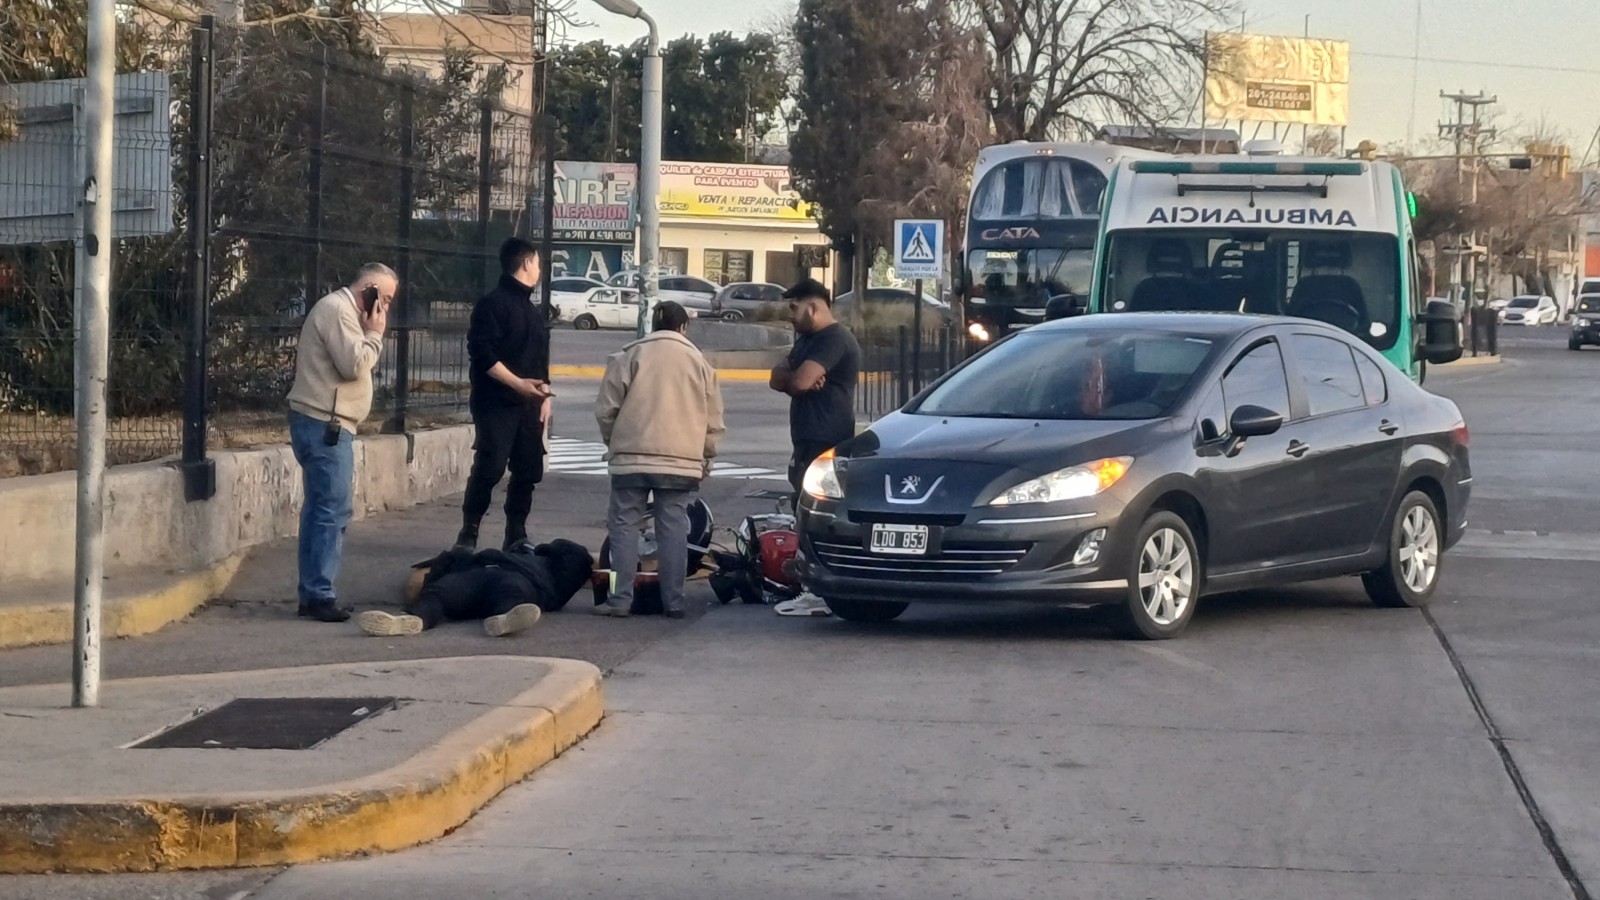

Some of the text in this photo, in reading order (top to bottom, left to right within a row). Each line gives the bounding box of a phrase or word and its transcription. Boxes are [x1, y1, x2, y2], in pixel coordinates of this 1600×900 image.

[695, 176, 759, 188] PARA EVENTOS
[698, 195, 727, 204] VENTA
[981, 227, 1041, 240] CATA
[902, 532, 925, 548] 853
